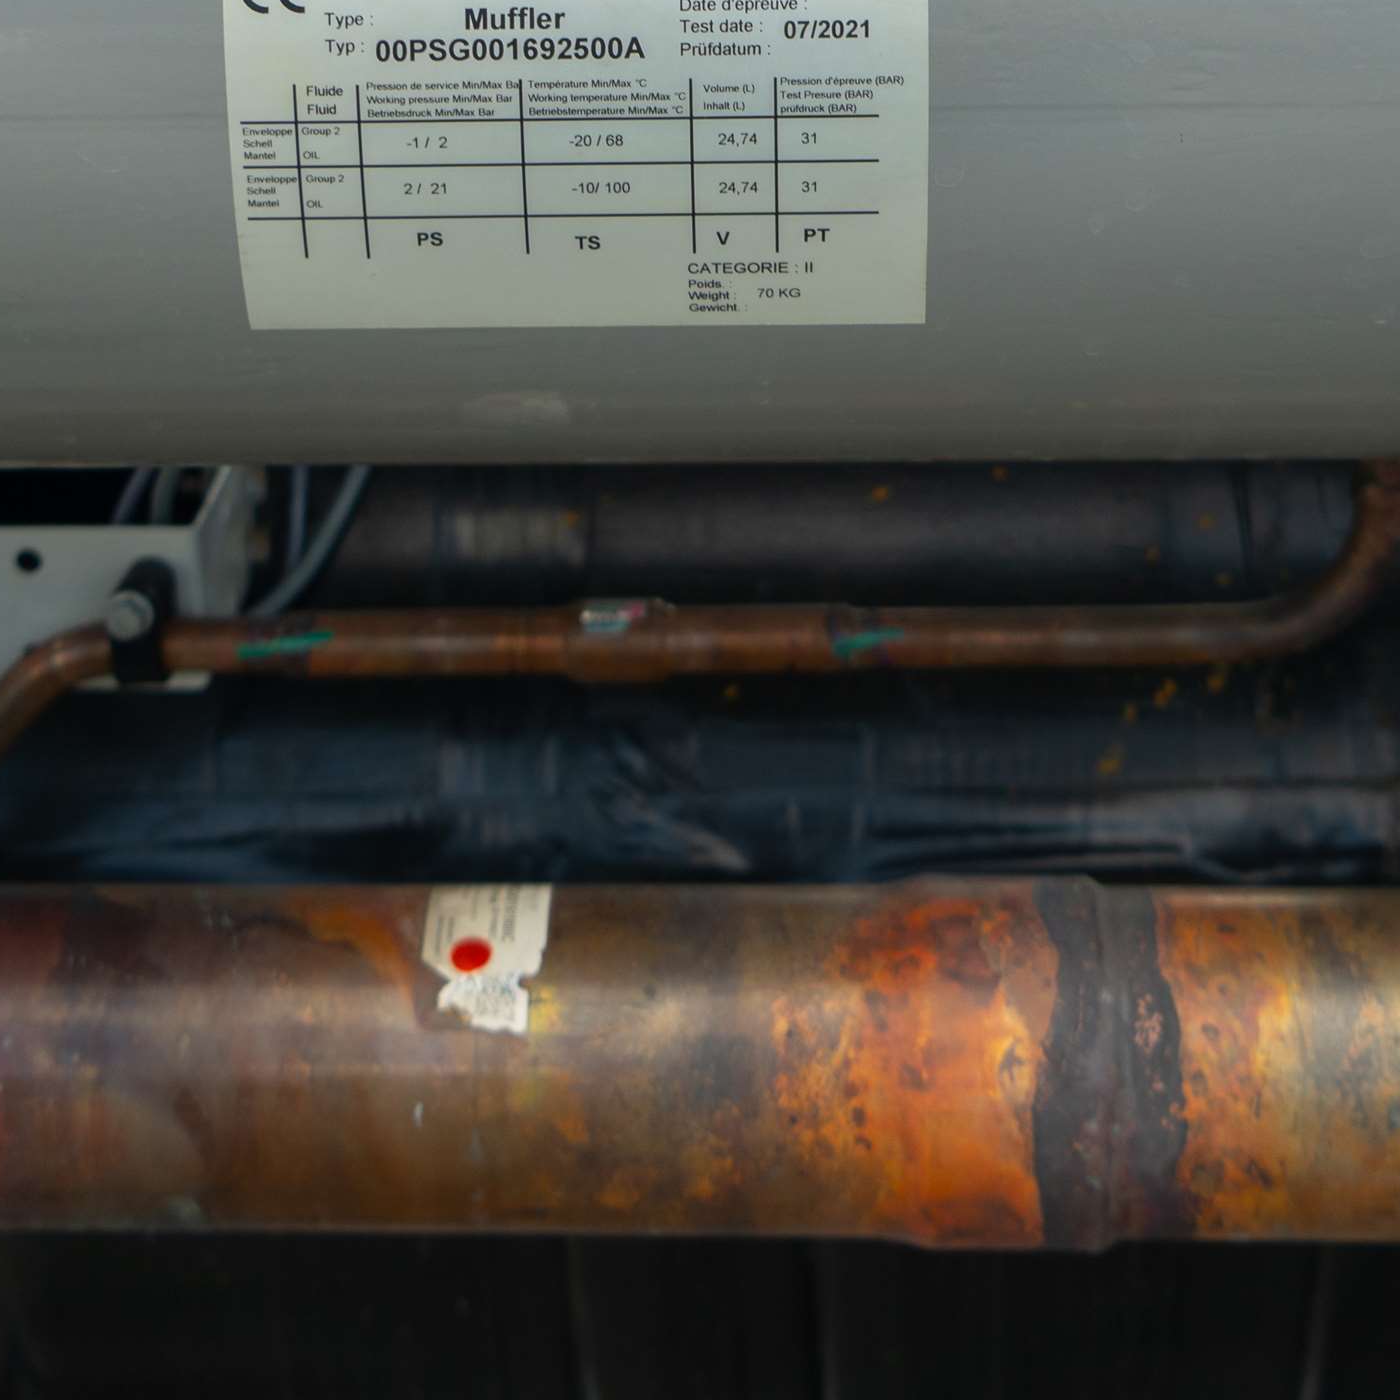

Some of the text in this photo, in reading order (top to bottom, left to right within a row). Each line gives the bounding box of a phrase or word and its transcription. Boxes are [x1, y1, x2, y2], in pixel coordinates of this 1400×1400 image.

[324, 12, 364, 30] Type
[465, 7, 565, 30] Muffler
[680, 19, 714, 33] Test
[719, 19, 753, 33] date
[784, 19, 869, 39] 07/2021
[325, 39, 355, 56] Typ
[376, 36, 645, 62] 00PSG001692500A
[680, 42, 761, 56] Prüfdatum
[366, 80, 522, 91] Pression de service Min/Max Ba
[528, 80, 589, 89] Température
[591, 79, 631, 88] Min/Max
[780, 75, 904, 86] Pression d'épreuve (BAR)
[306, 85, 343, 96] Fluide
[703, 84, 755, 94] Volume (L)
[366, 94, 512, 105] Working pressure Min/Max Bar
[528, 93, 568, 103] Working
[570, 93, 627, 103] temperature
[631, 92, 671, 101] Min/Max
[780, 90, 873, 100] Test Presure (BAR)
[307, 104, 336, 115] Fluid
[529, 107, 625, 117] Betriebstemperature
[628, 106, 668, 115] Min/Max
[704, 101, 745, 111] Inhalt (L)
[828, 103, 857, 114] (BAR)
[367, 108, 494, 118] Betriebsdruck Min/Max Bar
[242, 127, 293, 136] Enveloppe
[301, 127, 340, 137] Group 2
[243, 139, 272, 148] Schell
[407, 137, 418, 148] -1
[438, 136, 447, 149] 2
[570, 134, 592, 147] -20
[606, 134, 623, 147] 68
[718, 133, 757, 147] 24,74
[801, 132, 818, 145] 31
[244, 152, 276, 160] Mantel
[303, 151, 320, 160] OIL
[247, 175, 297, 184] Enveloppe
[305, 174, 344, 184] Group 2
[247, 187, 276, 195] Schell
[403, 183, 413, 195] 2
[430, 182, 447, 194] 21
[605, 182, 630, 193] 100
[719, 181, 758, 195] 24,74
[802, 181, 818, 193] 31
[248, 200, 279, 208] Mantel
[306, 200, 323, 208] OIL
[417, 232, 443, 246] PS
[716, 232, 730, 245] V
[804, 228, 830, 242] PT
[575, 236, 600, 250] TS
[688, 262, 789, 274] CATEGORIE
[688, 291, 730, 301] Weight
[757, 288, 774, 298] 70
[779, 288, 800, 298] KG
